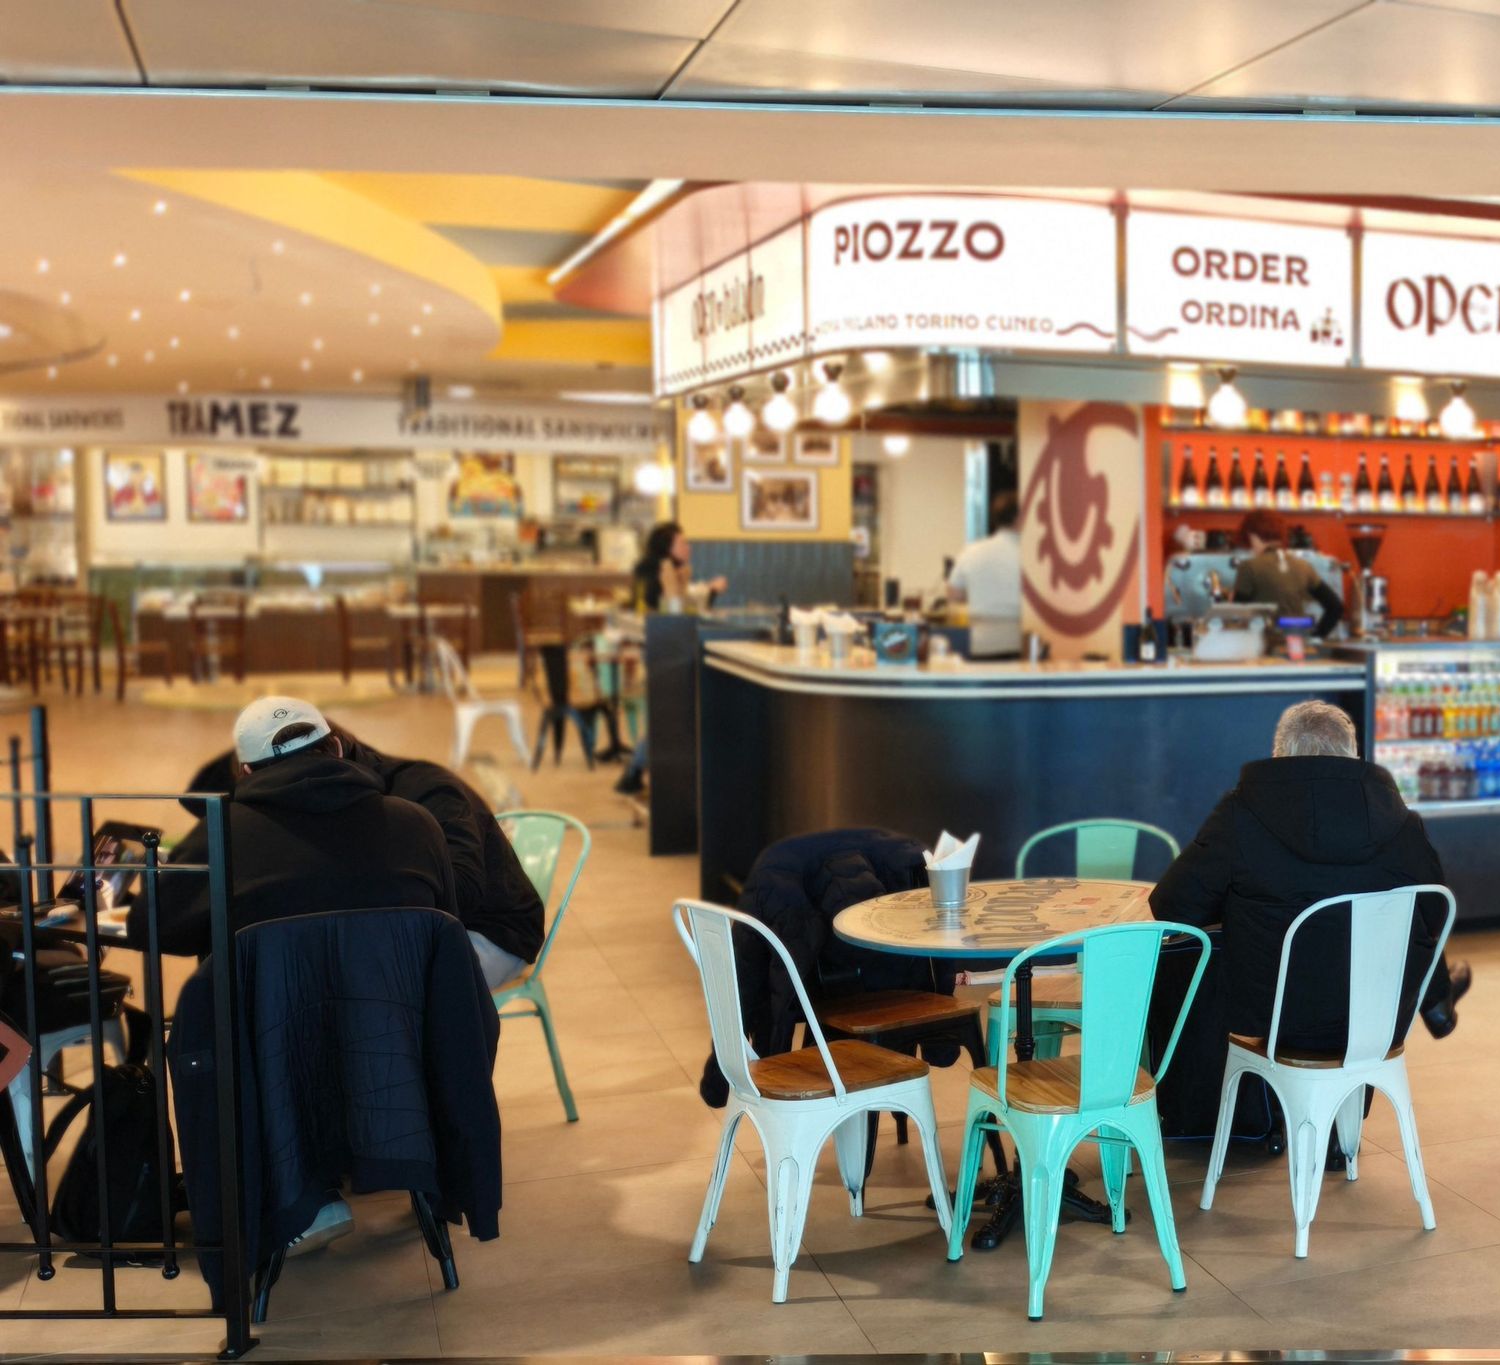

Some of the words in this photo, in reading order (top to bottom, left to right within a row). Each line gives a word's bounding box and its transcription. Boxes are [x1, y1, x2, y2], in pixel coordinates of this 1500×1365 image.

[835, 220, 1005, 265] PIOZZO
[1172, 246, 1309, 287] ORDER
[904, 313, 980, 332] TORINO
[985, 315, 1054, 333] CUNEO
[1181, 300, 1300, 331] ORDINA
